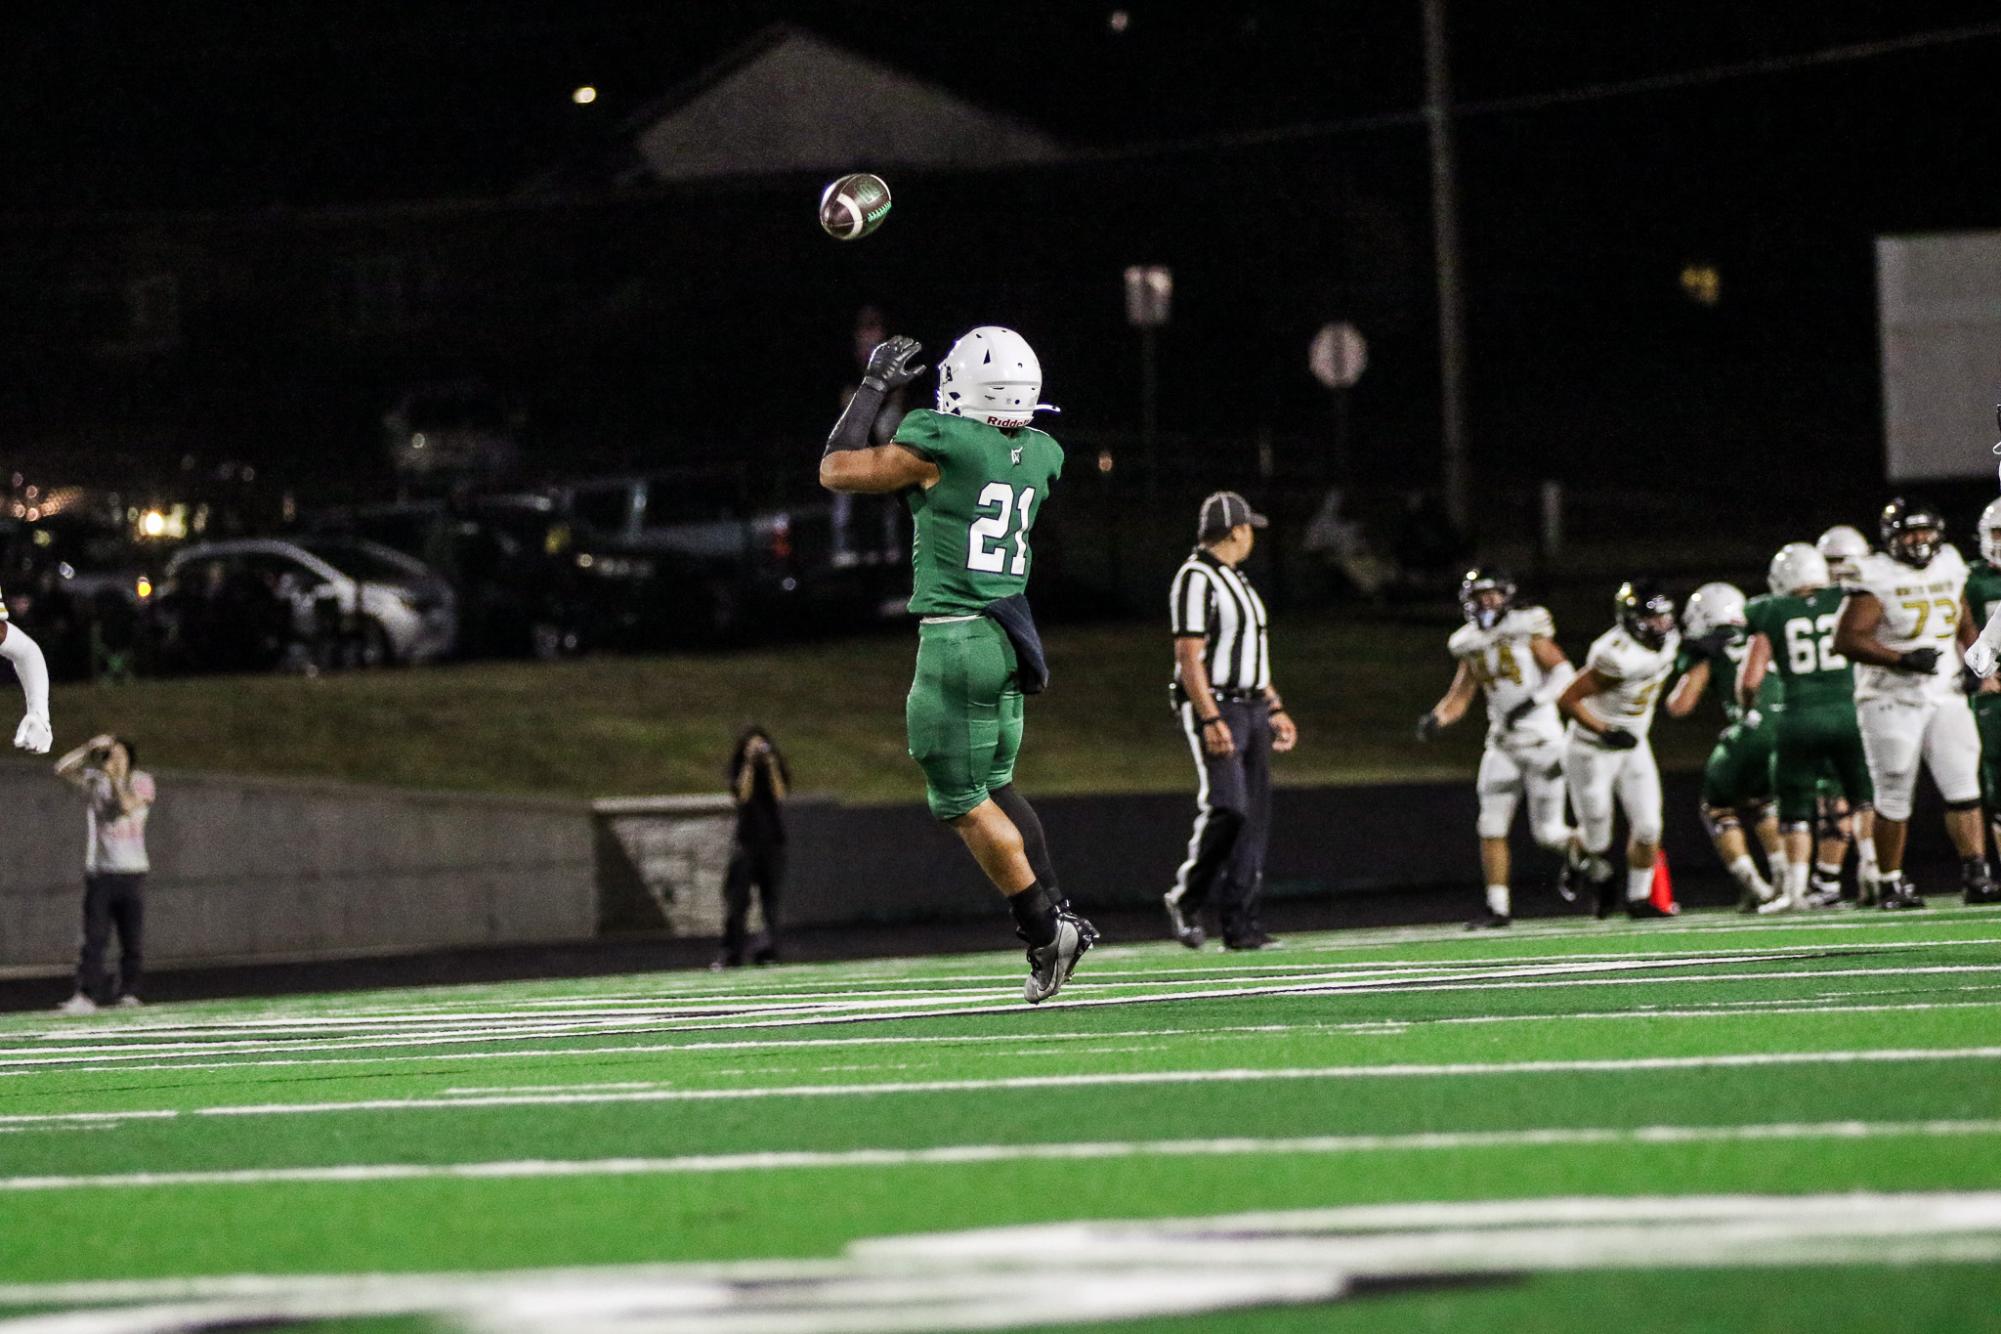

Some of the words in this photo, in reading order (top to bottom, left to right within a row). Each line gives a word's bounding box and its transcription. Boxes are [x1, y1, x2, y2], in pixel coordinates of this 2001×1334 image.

[967, 482, 1035, 575] 21
[1784, 613, 1848, 675] 62
[1902, 599, 1957, 639] 73
